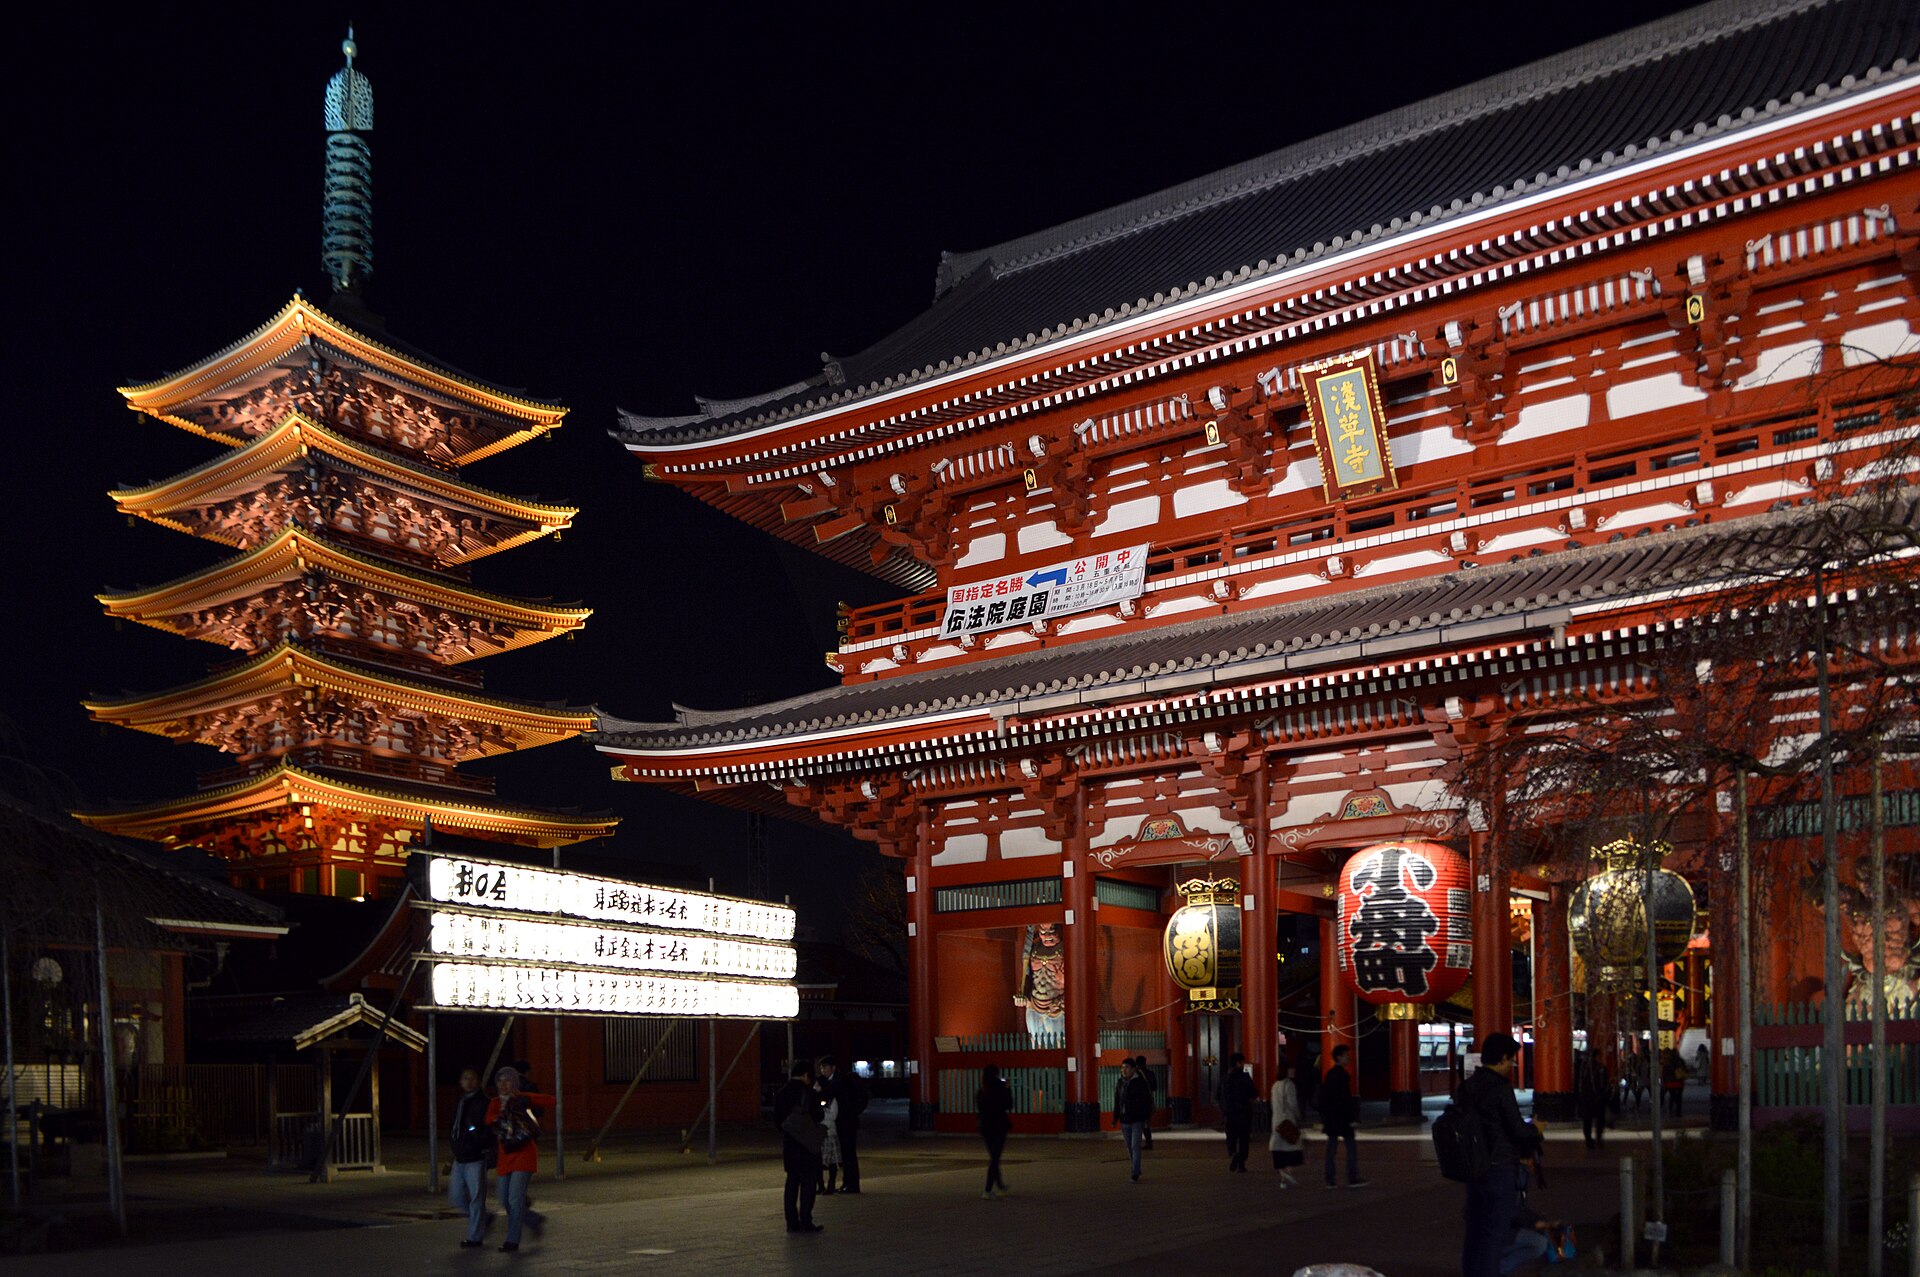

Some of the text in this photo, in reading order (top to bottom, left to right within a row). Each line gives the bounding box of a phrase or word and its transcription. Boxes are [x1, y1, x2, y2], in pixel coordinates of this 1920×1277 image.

[1074, 550, 1131, 575] 公開中
[951, 576, 1025, 603] 国指定名勝
[1066, 574, 1084, 584] 入口
[946, 590, 1050, 634] 伝法院庭園
[1349, 846, 1441, 997] 小舟町
